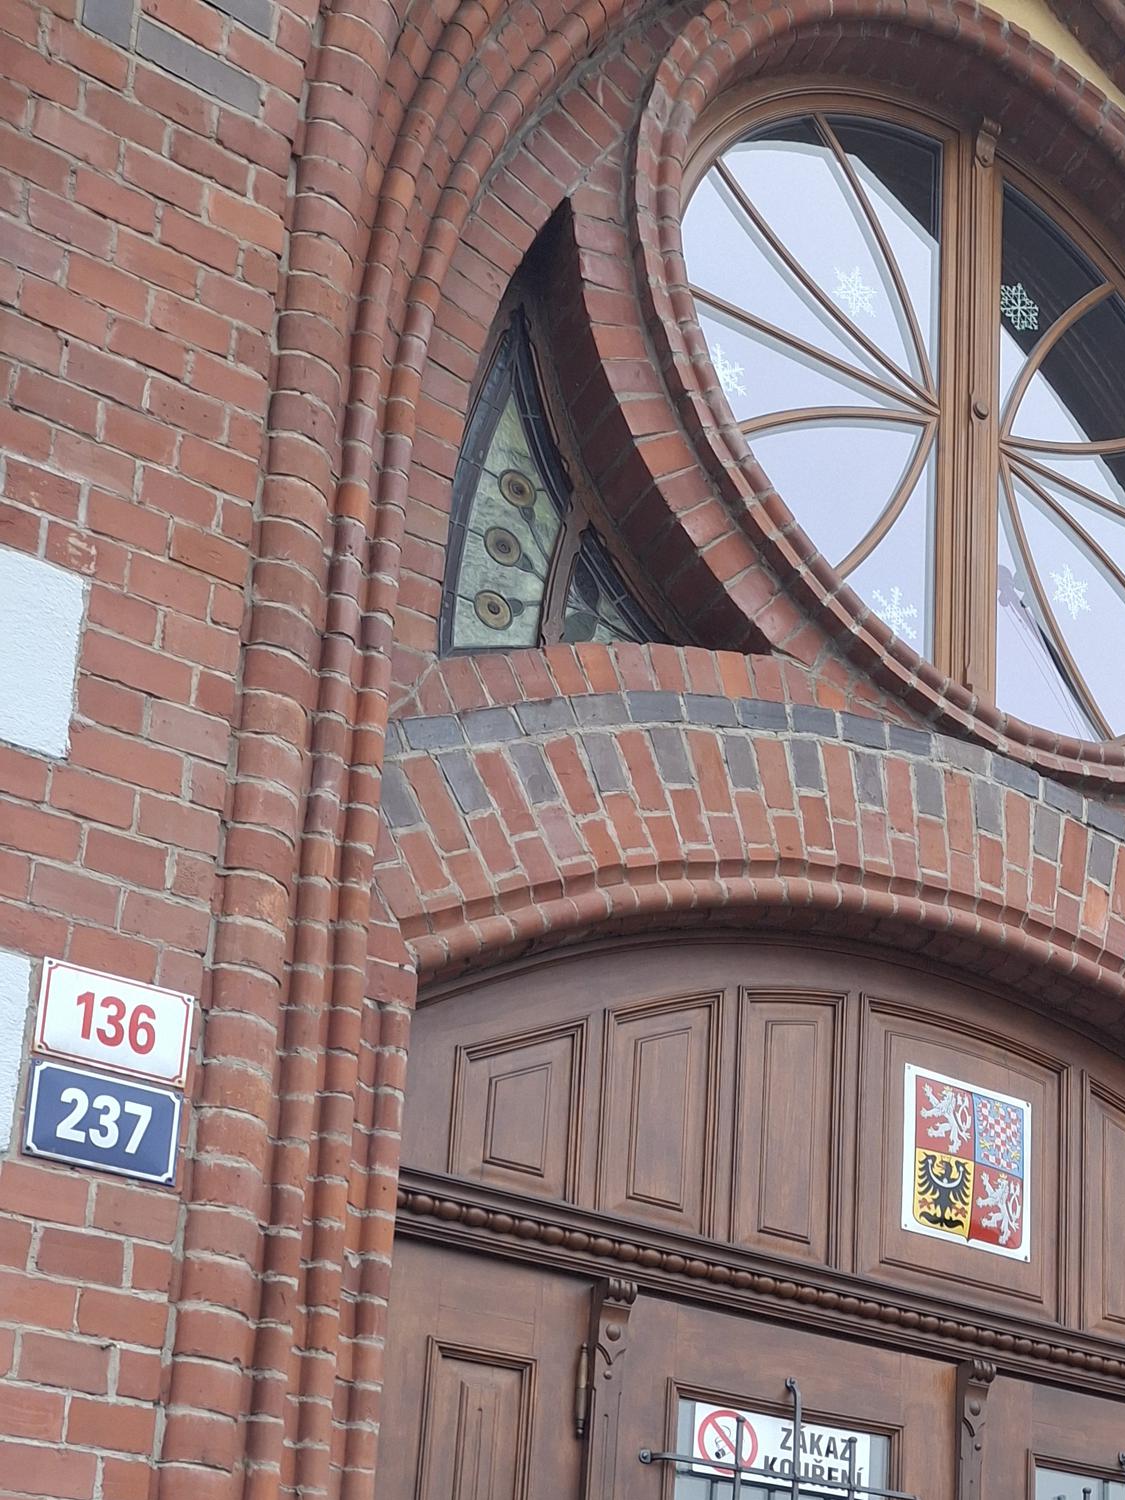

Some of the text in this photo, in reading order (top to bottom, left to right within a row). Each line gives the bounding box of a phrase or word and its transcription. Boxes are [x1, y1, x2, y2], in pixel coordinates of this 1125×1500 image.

[76, 991, 156, 1055] 136
[55, 1087, 152, 1155] 237
[780, 1425, 850, 1462] ZÁKAZ
